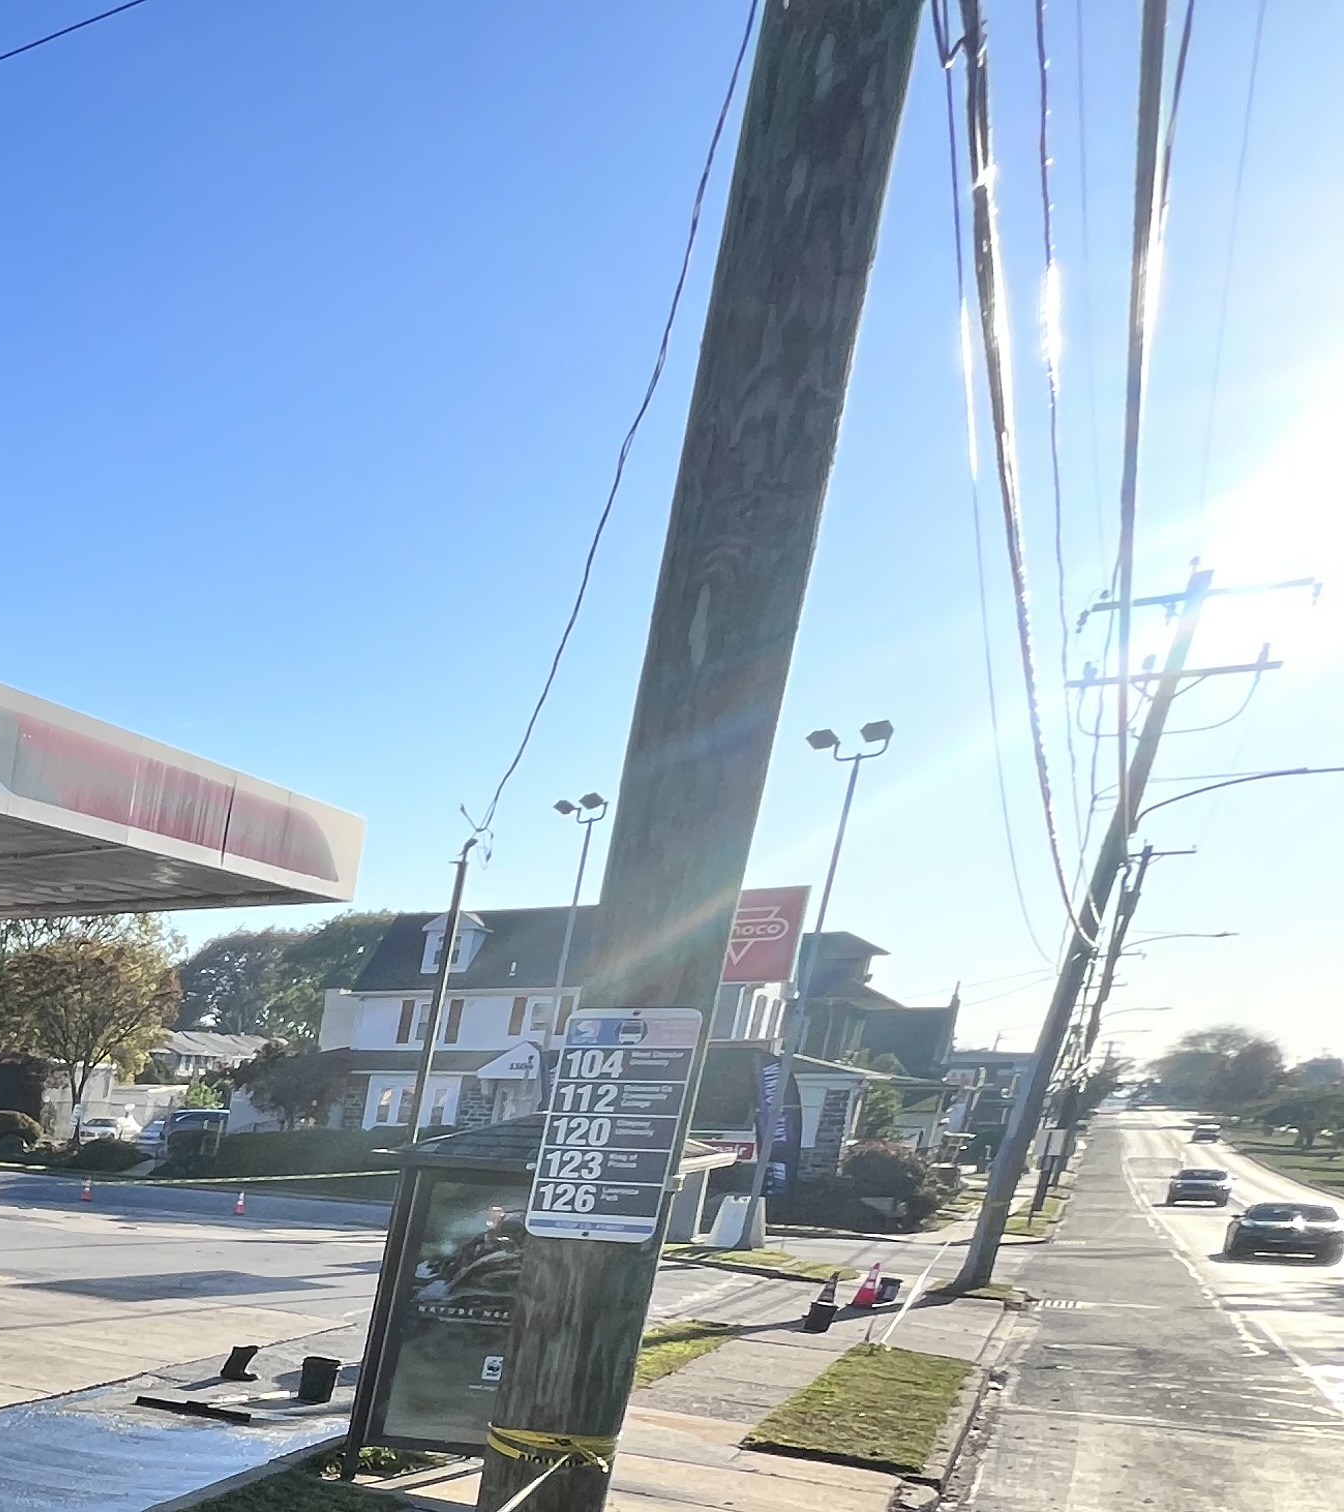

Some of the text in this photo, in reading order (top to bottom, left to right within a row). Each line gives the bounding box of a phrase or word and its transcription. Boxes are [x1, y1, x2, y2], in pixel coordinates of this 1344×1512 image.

[566, 1050, 624, 1079] 104
[560, 1084, 619, 1112] 112
[553, 1117, 611, 1146] 120
[546, 1150, 604, 1180] 123
[539, 1184, 597, 1213] 126
